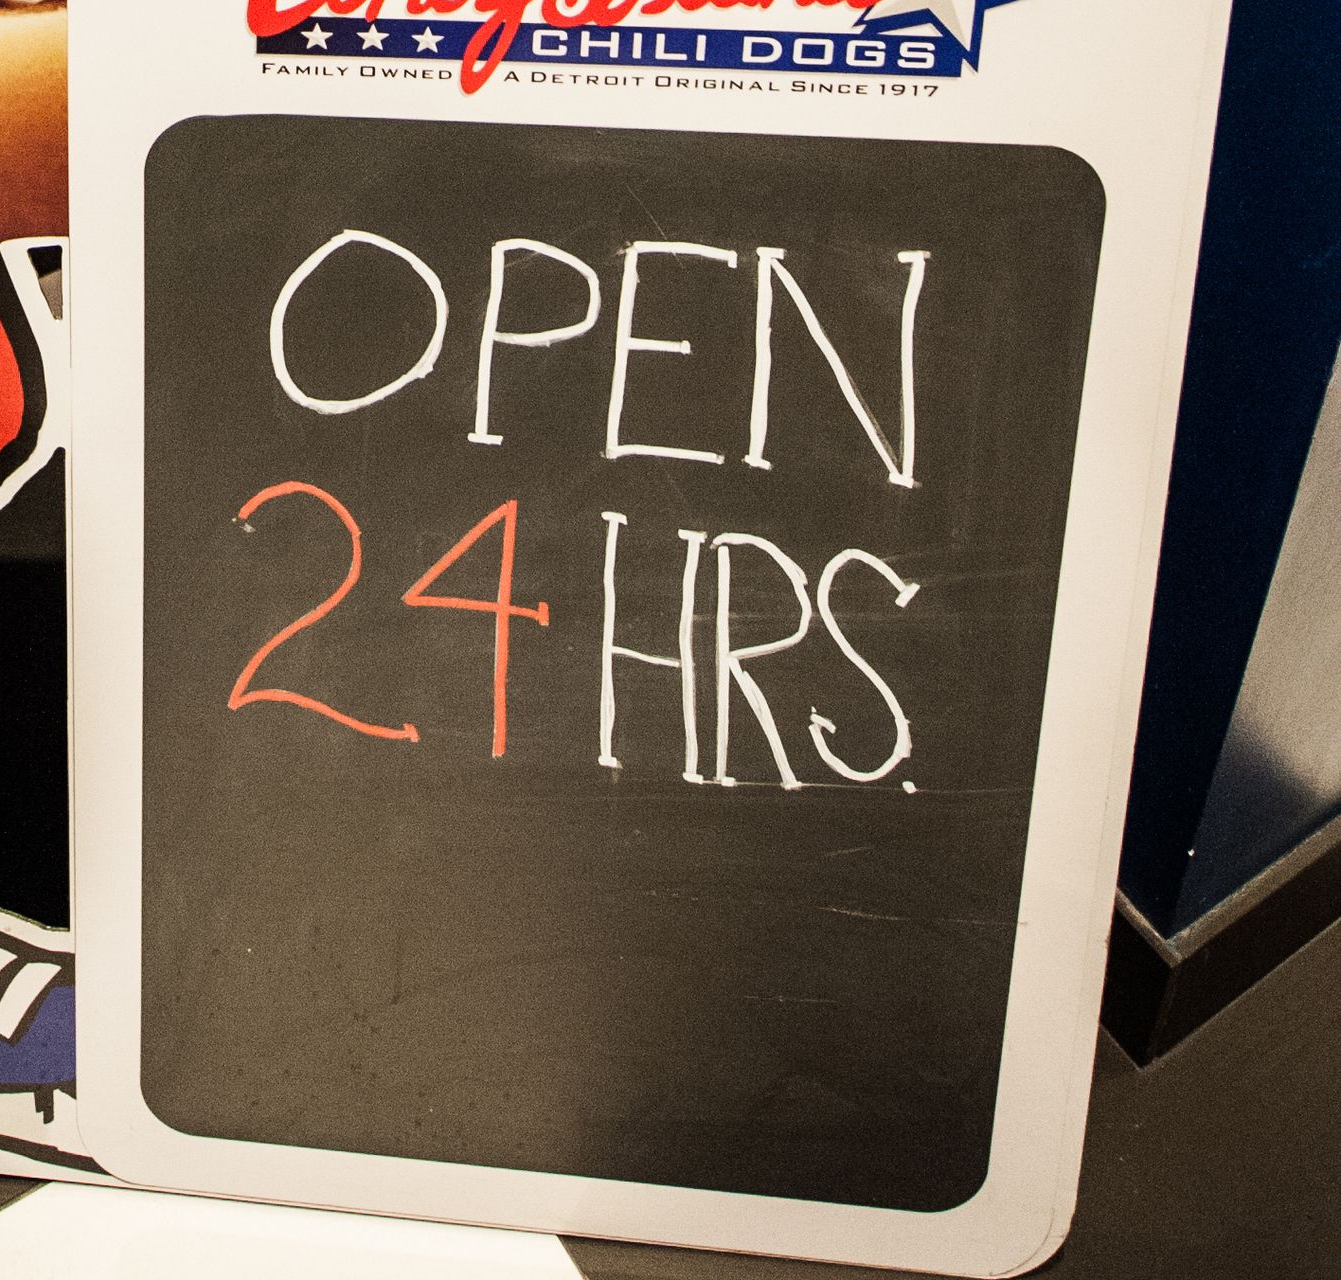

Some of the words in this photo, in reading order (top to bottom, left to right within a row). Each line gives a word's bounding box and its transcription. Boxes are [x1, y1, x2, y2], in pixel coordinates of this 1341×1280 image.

[261, 62, 349, 77] FAMILY
[360, 65, 453, 81] OWNED
[504, 70, 520, 83] A
[531, 71, 645, 87] DETROIT
[655, 75, 780, 93] ORIGINAL
[791, 80, 869, 95] SINCE
[879, 83, 939, 98] 1917
[532, 28, 707, 62] CHILI
[741, 36, 936, 70] DOGS
[269, 228, 927, 488] OPEN
[229, 481, 550, 758] 24
[598, 511, 921, 793] HRS.
